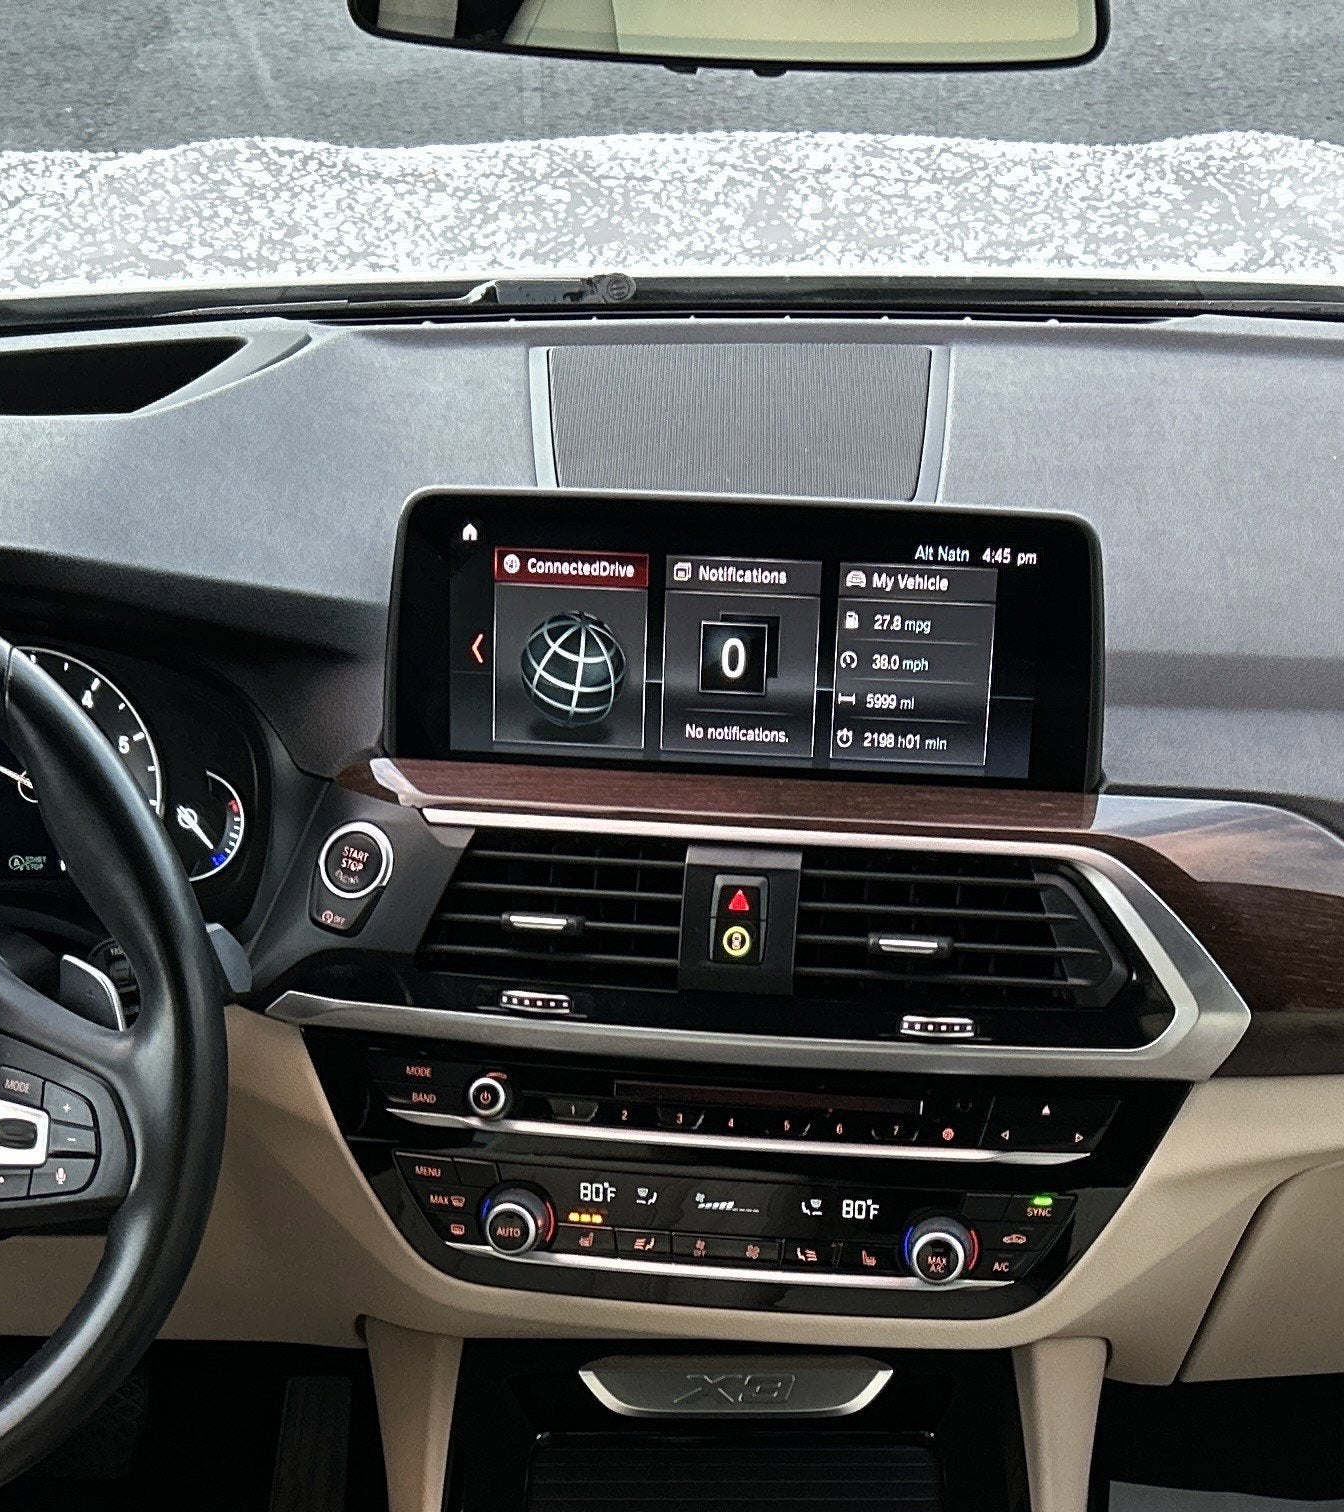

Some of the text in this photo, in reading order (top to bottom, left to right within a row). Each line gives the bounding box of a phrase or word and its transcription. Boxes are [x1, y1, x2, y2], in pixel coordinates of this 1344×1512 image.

[914, 545, 934, 561] Alt
[982, 548, 1011, 564] 4:45
[1017, 551, 1037, 566] pm
[527, 557, 635, 578] ConnectedDrive
[698, 564, 787, 585] Notifications
[872, 572, 949, 592] My Vehicle
[873, 614, 931, 634] 27.8 mpg
[721, 637, 746, 679] 0
[902, 657, 929, 673] mph
[81, 689, 94, 709] 4
[684, 723, 704, 740] No
[118, 734, 130, 754] 5
[342, 845, 370, 862] START
[340, 857, 364, 872] STOP
[406, 1064, 433, 1079] MODE
[411, 1091, 437, 1104] BAND
[415, 1165, 442, 1178] MENU
[429, 1194, 450, 1206] MAX
[1026, 1207, 1053, 1217] SYNC
[496, 1226, 522, 1238] AUTO
[992, 1261, 1010, 1272] A/C
